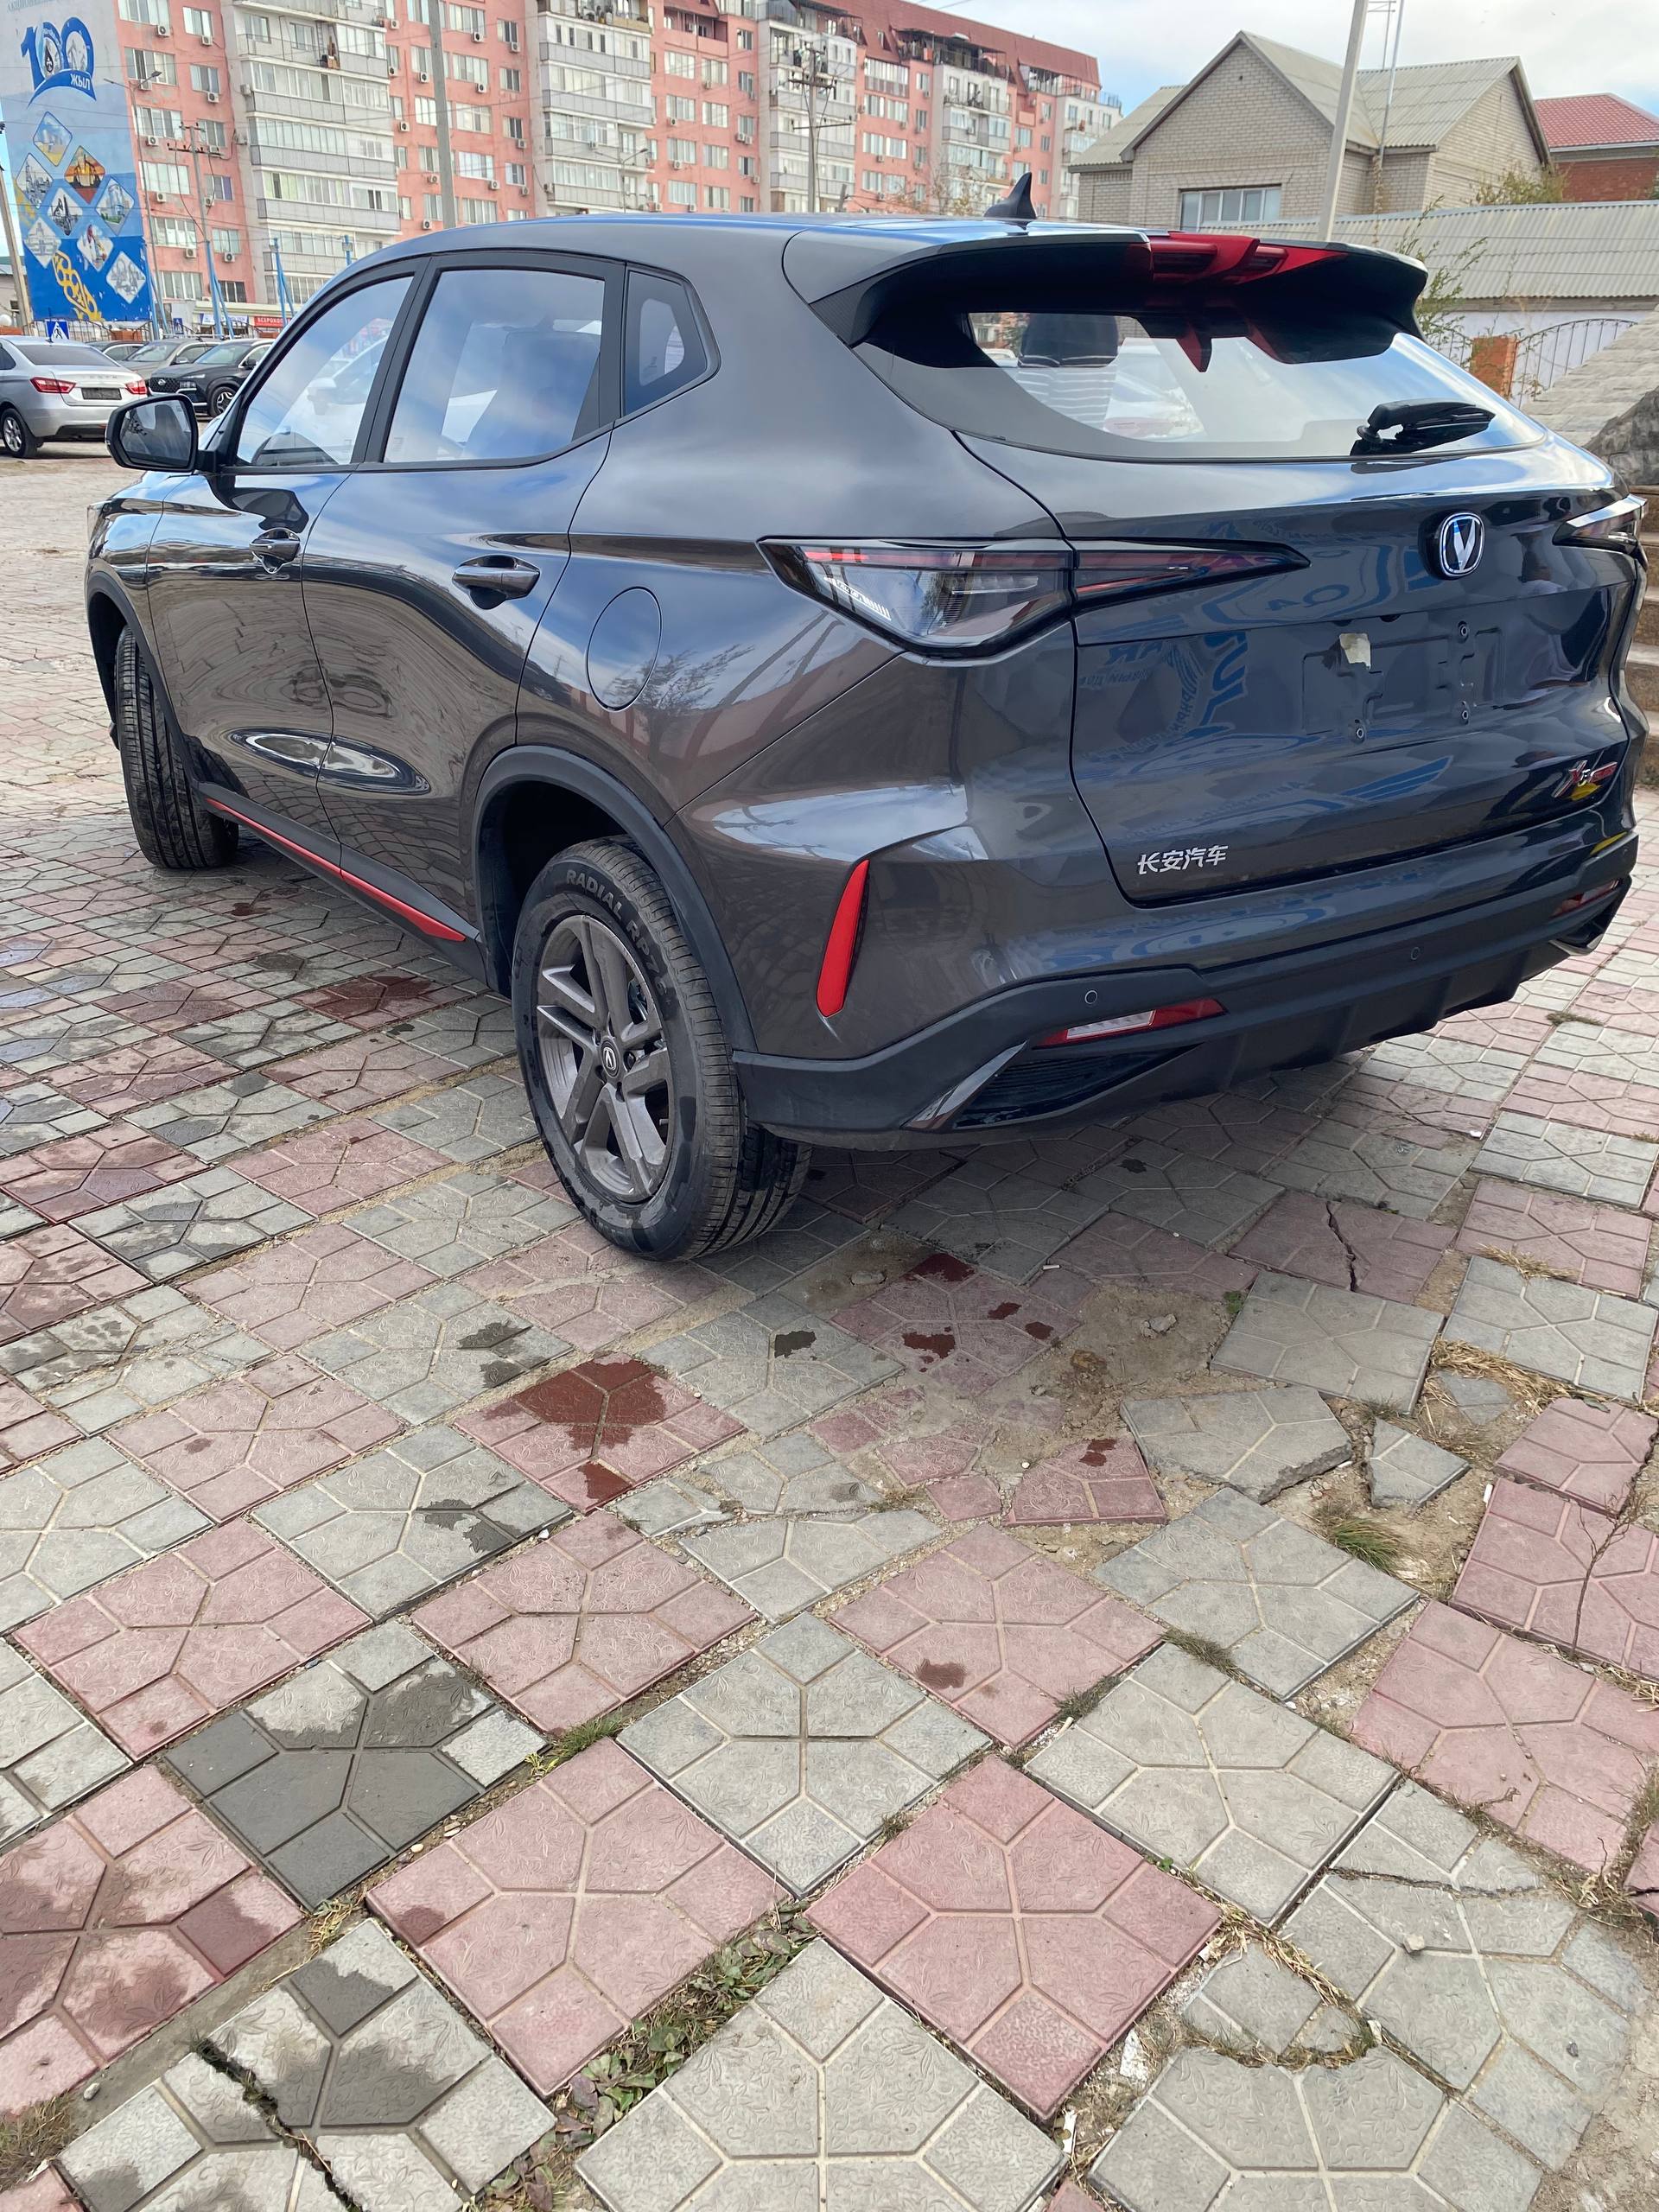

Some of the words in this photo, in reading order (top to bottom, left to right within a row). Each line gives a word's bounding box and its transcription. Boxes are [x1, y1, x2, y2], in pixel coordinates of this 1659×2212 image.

[70, 73, 91, 91] ЖЫЛ
[1137, 844, 1229, 875] 长安汽车
[566, 869, 623, 919] RADIAL
